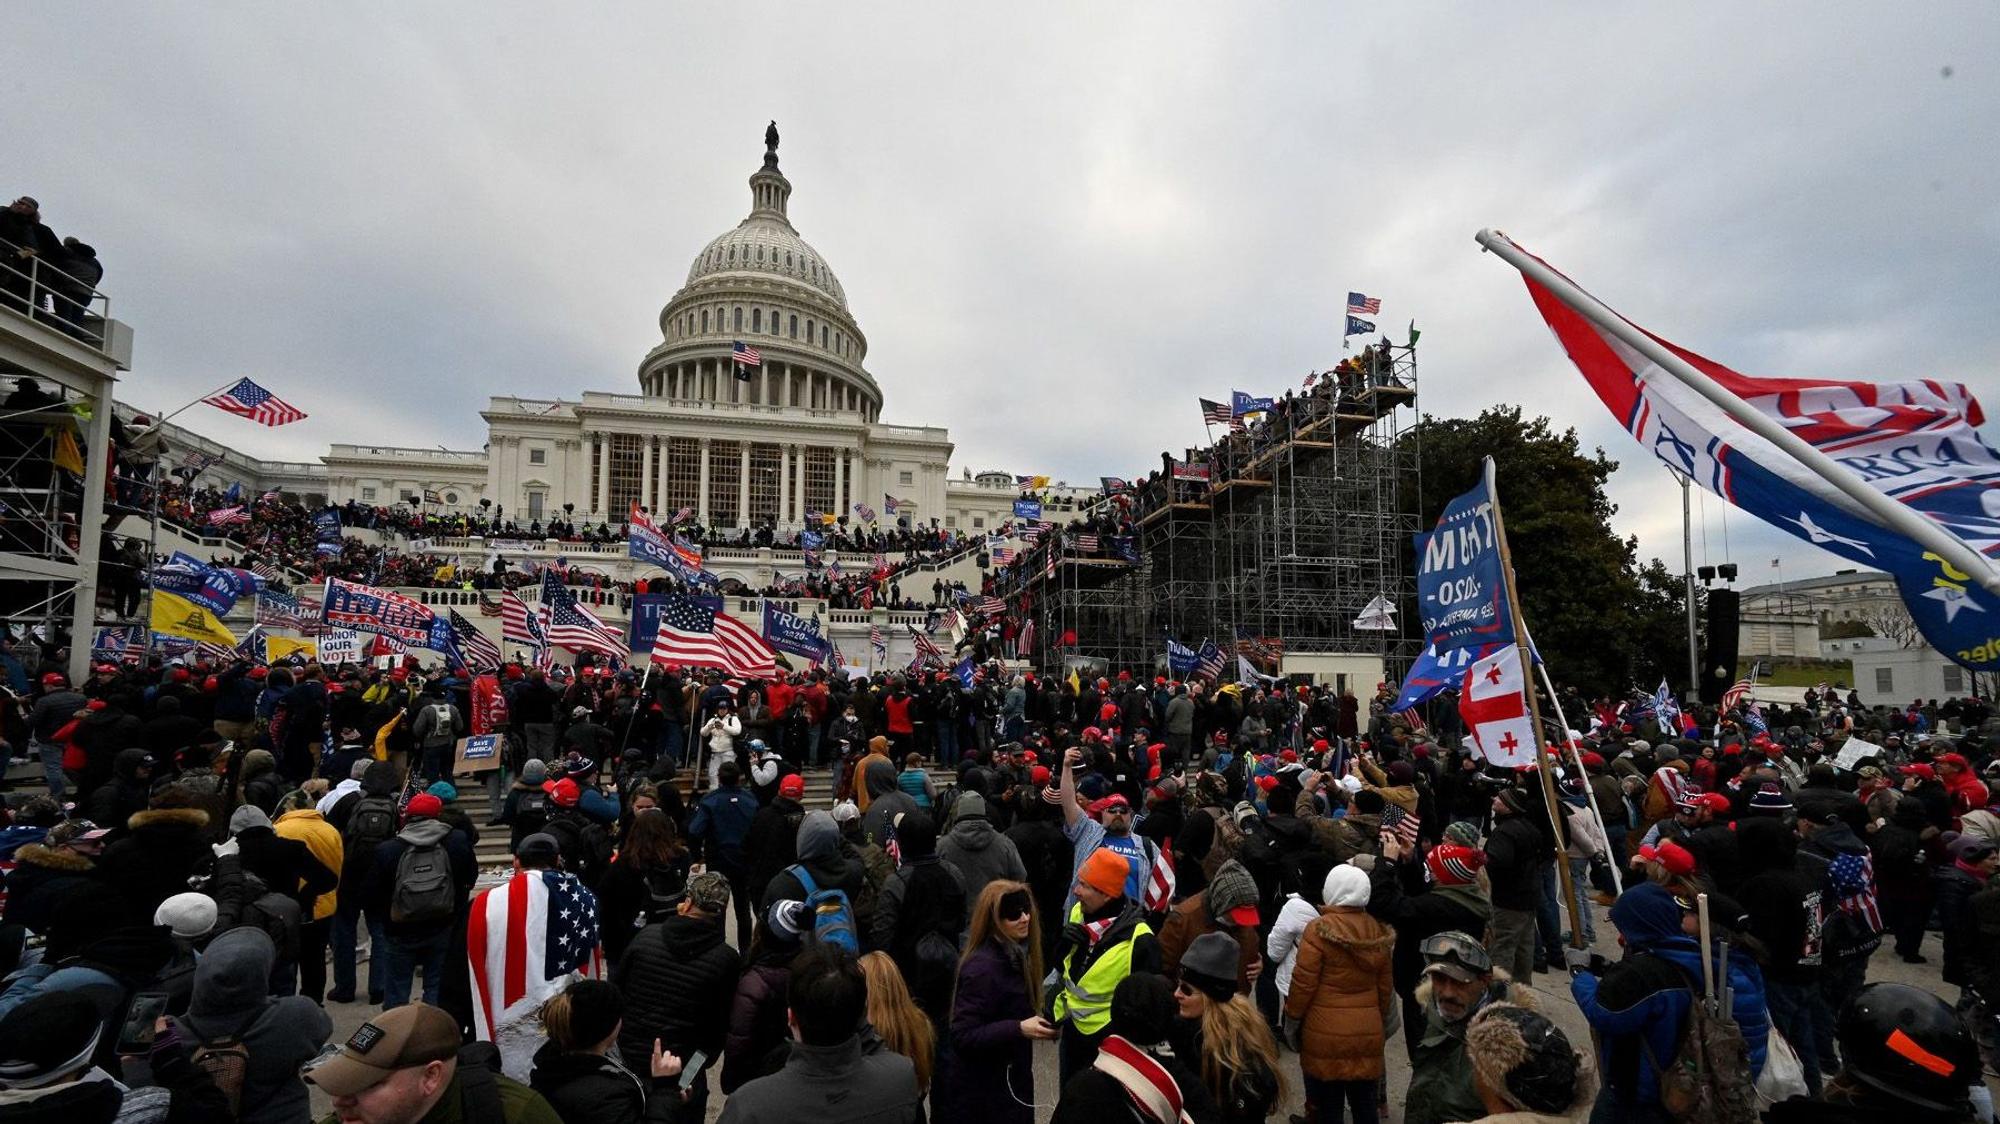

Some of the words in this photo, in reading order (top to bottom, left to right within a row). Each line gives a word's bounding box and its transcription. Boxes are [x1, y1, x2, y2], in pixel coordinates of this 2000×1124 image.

[320, 630, 357, 641] HONOR
[325, 641, 352, 651] OUR
[322, 651, 356, 661] VOTE
[466, 746, 493, 754] AMERICA
